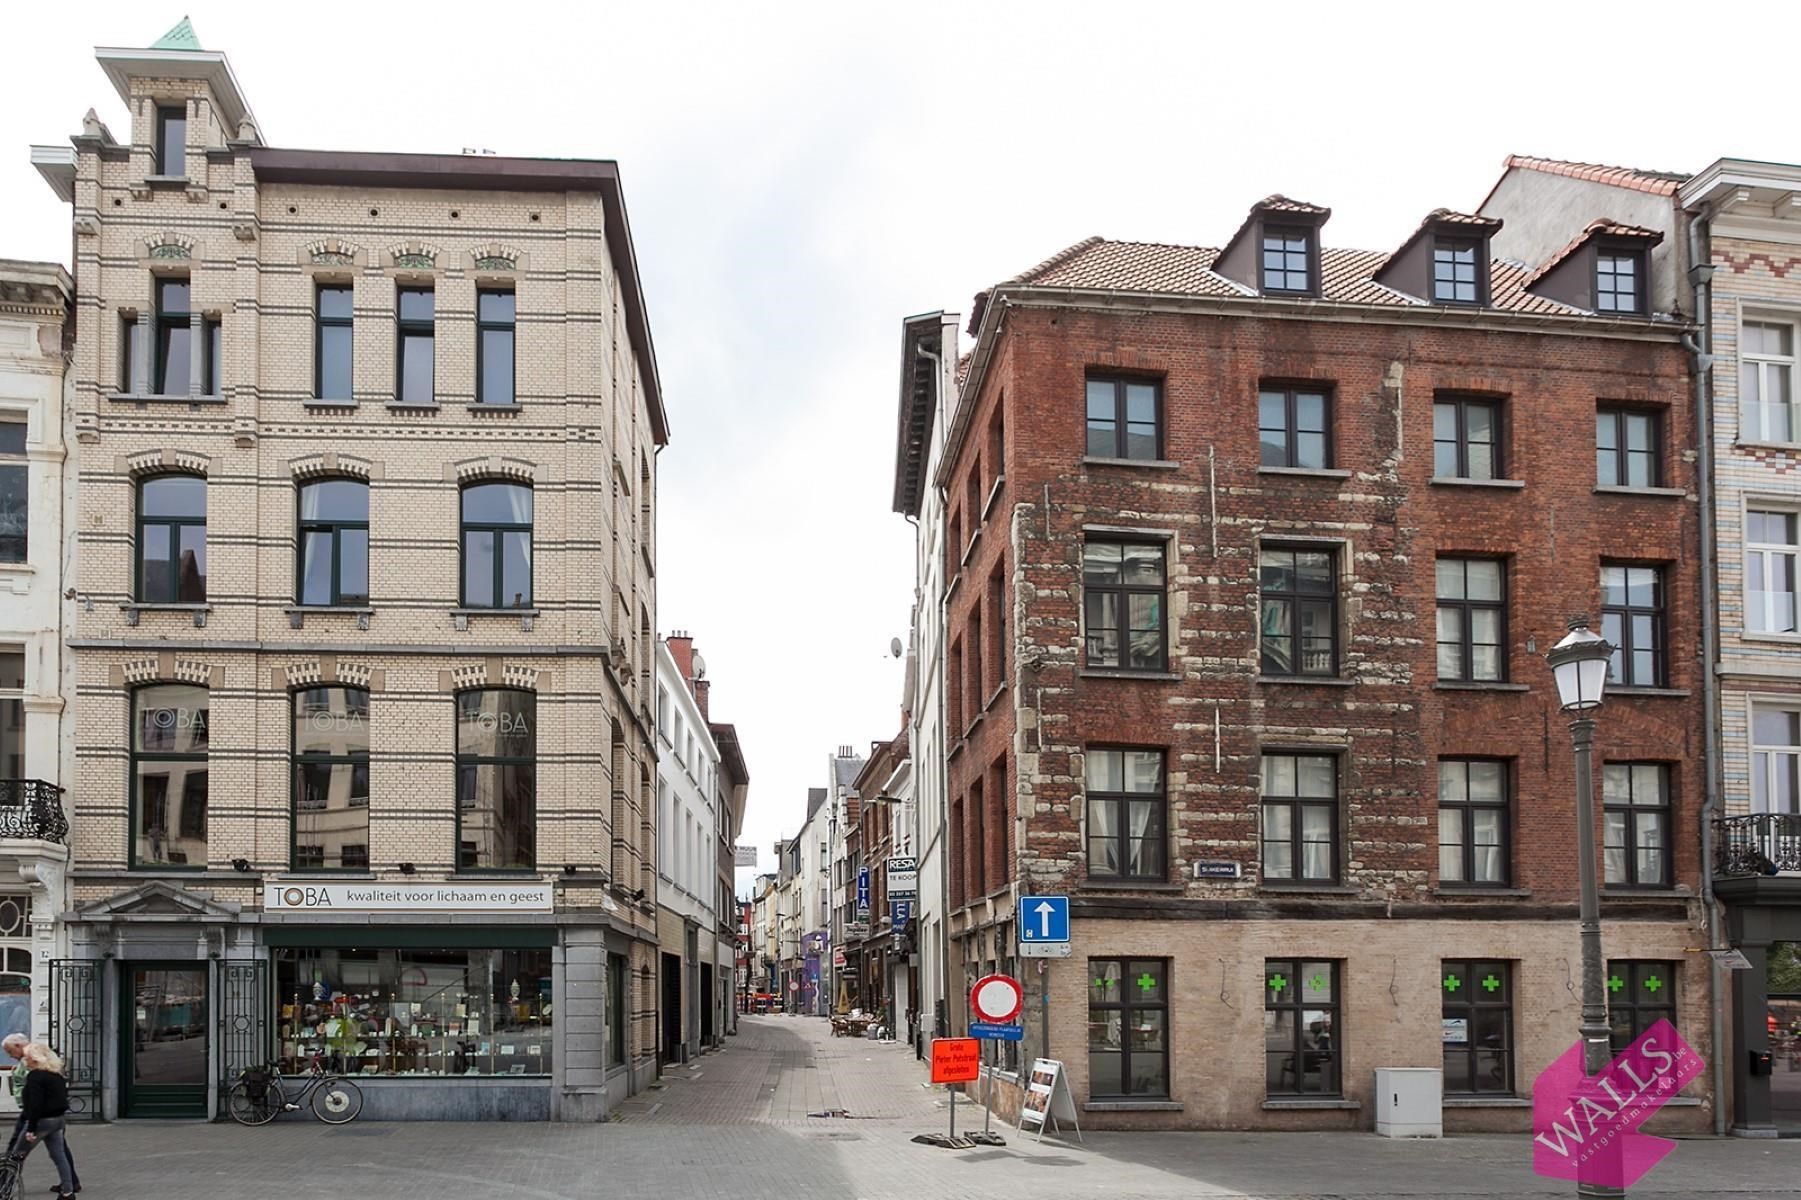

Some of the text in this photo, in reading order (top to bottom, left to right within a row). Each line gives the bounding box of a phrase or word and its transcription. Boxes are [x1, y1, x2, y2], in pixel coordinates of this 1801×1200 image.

[144, 707, 206, 729] TOBA
[304, 710, 366, 732] TOBA
[465, 711, 529, 733] TOBA
[273, 887, 544, 907] TOBA kwaliteit voor lichaam en geest
[859, 866, 869, 909] PITA
